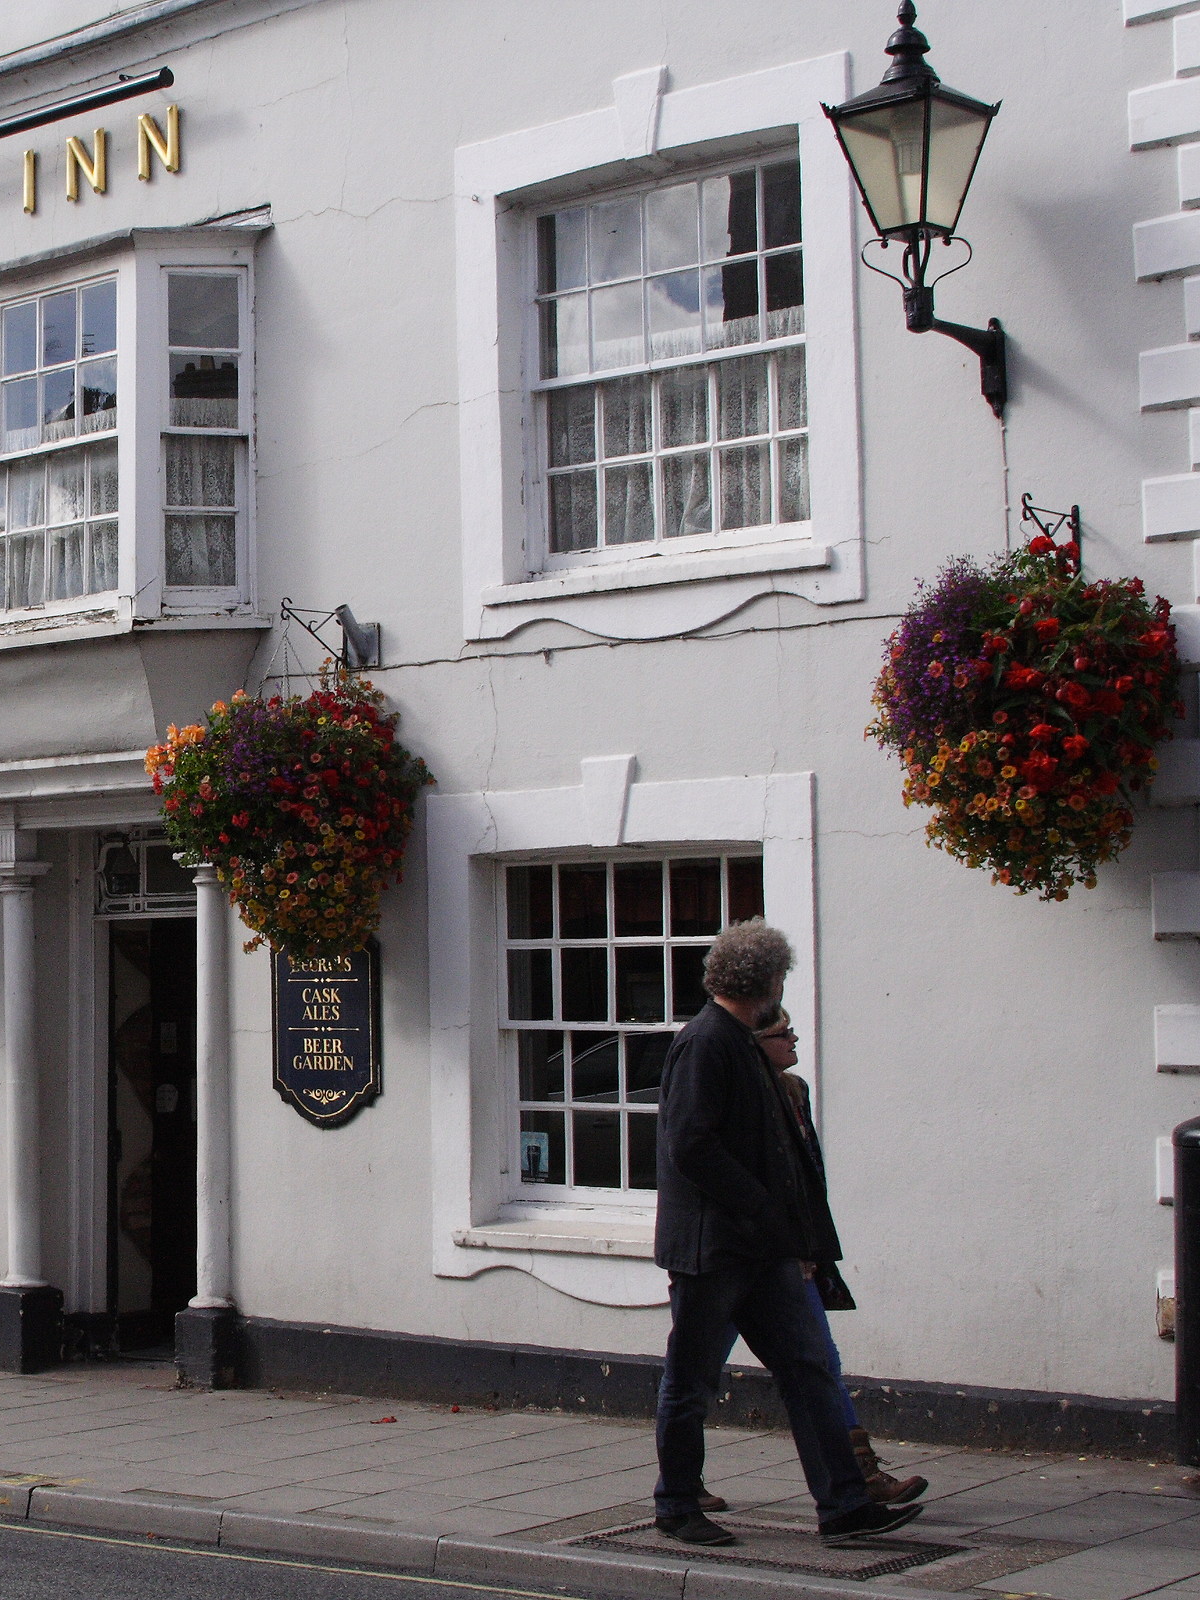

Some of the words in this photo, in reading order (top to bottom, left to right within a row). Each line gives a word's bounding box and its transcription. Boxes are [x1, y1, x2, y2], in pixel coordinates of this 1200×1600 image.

[22, 103, 180, 215] INN
[302, 987, 341, 1004] CASK
[302, 1005, 340, 1021] ALES
[303, 1038, 344, 1054] BEER
[293, 1055, 354, 1071] GARDEN
